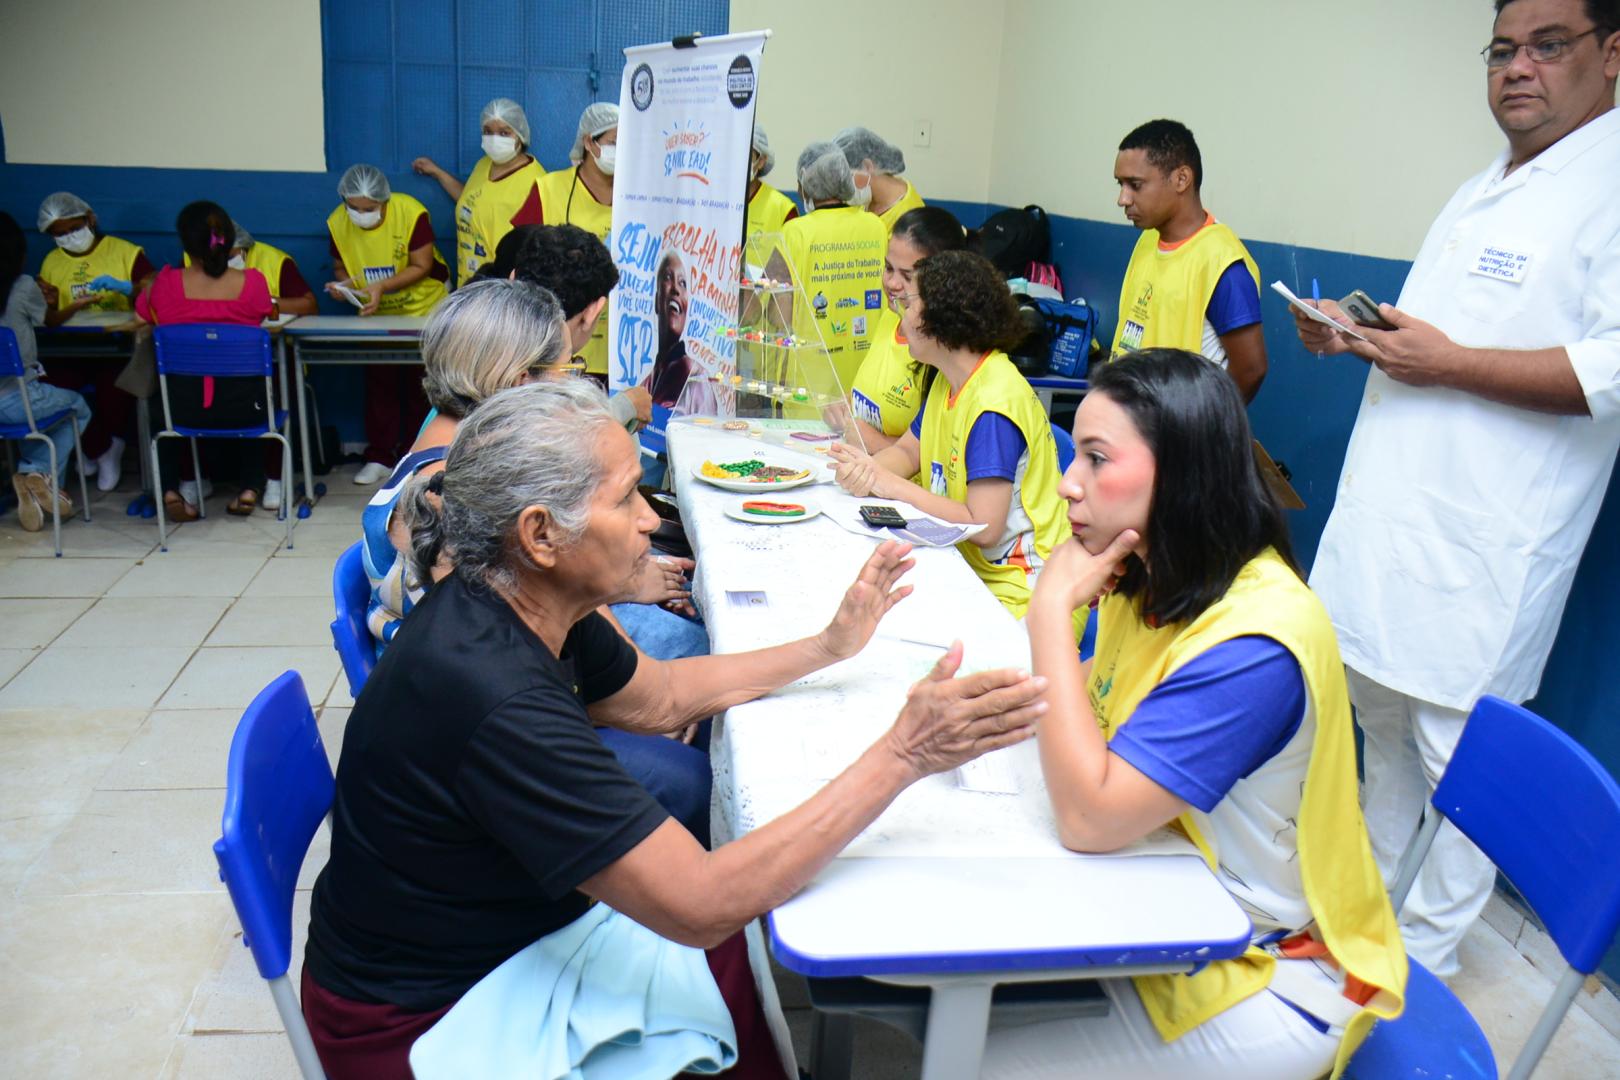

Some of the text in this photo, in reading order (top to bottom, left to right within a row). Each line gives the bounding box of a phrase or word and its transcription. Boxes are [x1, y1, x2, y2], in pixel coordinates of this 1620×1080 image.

[688, 150, 712, 174] EAD!
[662, 222, 718, 272] ESCOLHA
[810, 240, 880, 254] PROGRAMAS SOCIAIS
[1484, 246, 1514, 260] TÉCNICO
[814, 258, 881, 272] A Justiça do Trabalho
[1478, 256, 1515, 268] NUTRIÇÃO
[811, 274, 830, 282] mais
[856, 271, 864, 279] de
[1478, 265, 1514, 278] DIETÉTICA
[618, 268, 656, 296] QUEM
[690, 266, 738, 320] CAMINH
[616, 314, 652, 386] SER
